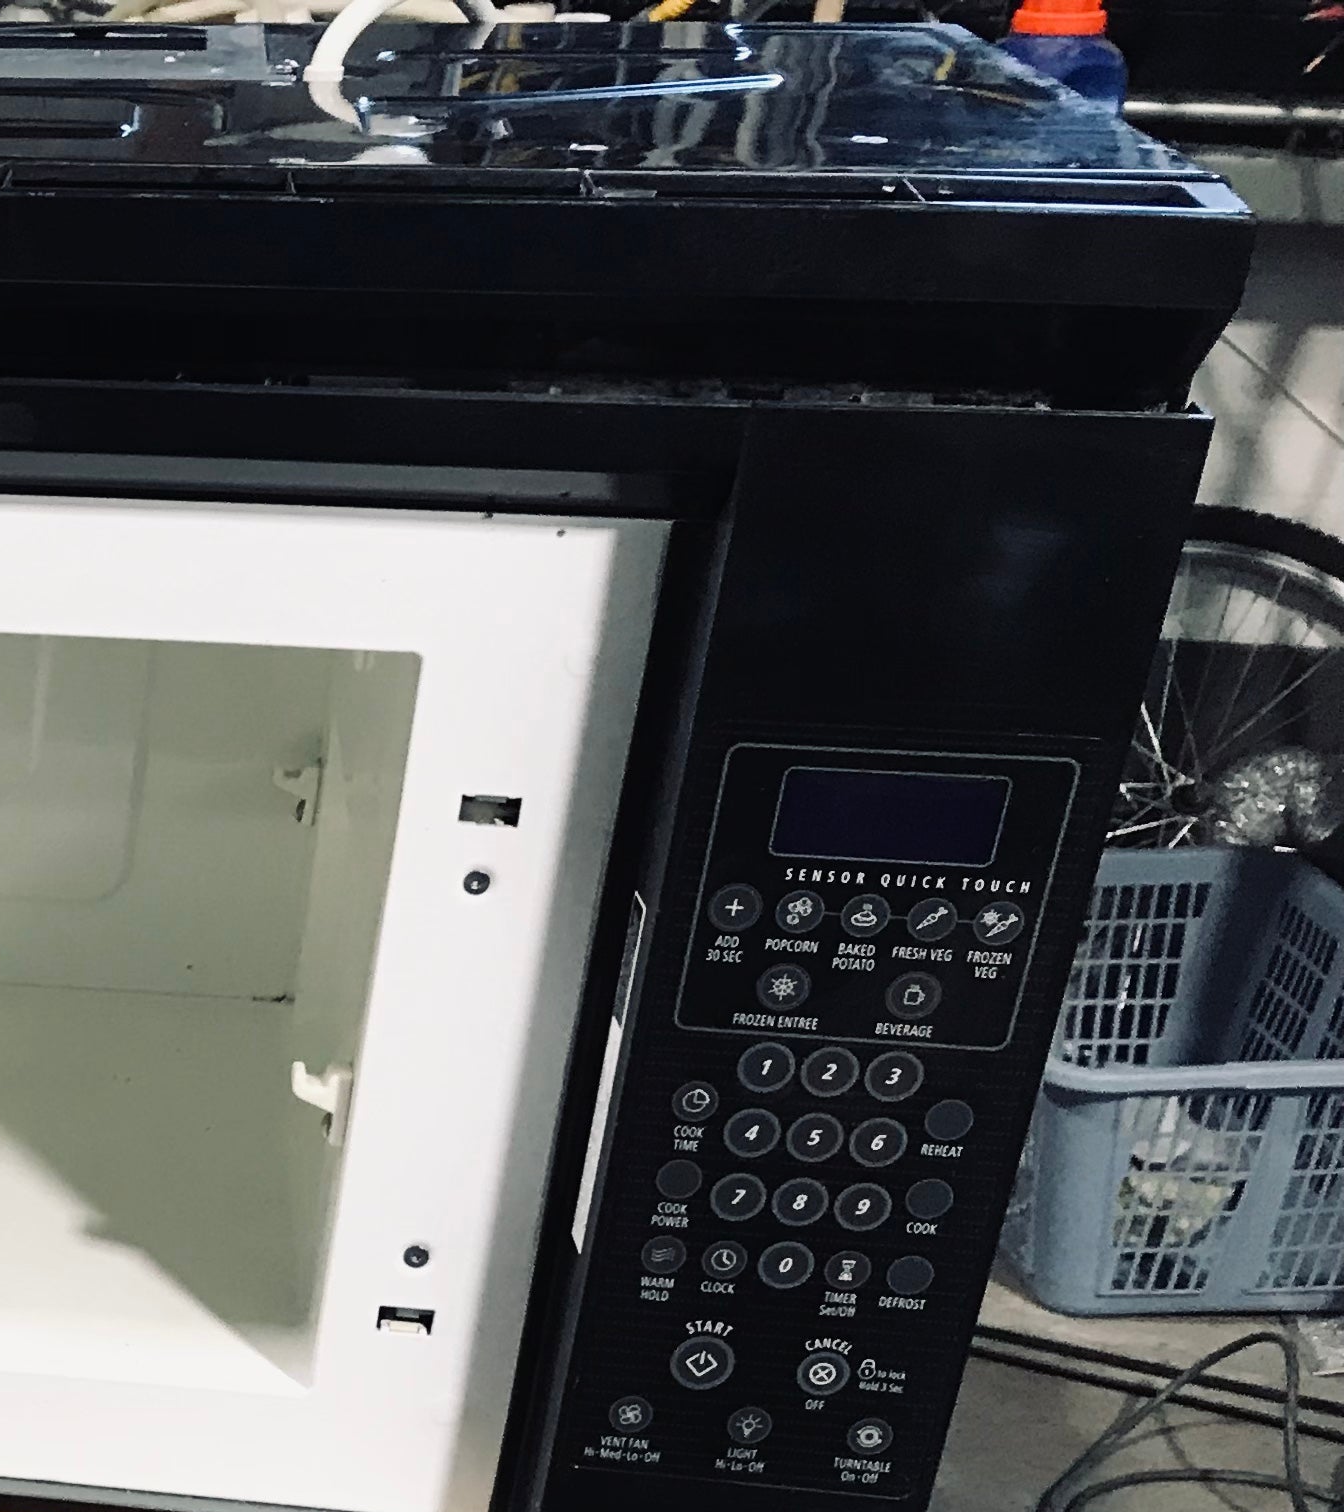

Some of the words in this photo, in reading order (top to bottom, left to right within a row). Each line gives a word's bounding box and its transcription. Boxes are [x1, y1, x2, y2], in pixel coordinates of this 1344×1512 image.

[785, 868, 865, 884] SENSOR
[880, 873, 946, 889] QUICK
[962, 878, 1031, 893] TOUCH
[715, 935, 739, 948] ADD
[765, 938, 820, 953] POPCORN
[706, 949, 720, 962] 30
[722, 950, 743, 963] SEC
[838, 943, 876, 956] BAKED
[892, 946, 928, 960] FRESH
[930, 948, 953, 962] VEG
[832, 957, 875, 971] POTATO
[967, 951, 1012, 965] FROZEN
[974, 966, 997, 979] VEG
[732, 1012, 776, 1027] FROZEN
[777, 1016, 818, 1030] ENTREE
[875, 1022, 933, 1038] BEVERAGE
[761, 1059, 773, 1075] 1
[821, 1063, 838, 1080] 2
[885, 1067, 902, 1085] 3
[673, 1125, 705, 1138] COOK
[745, 1125, 760, 1141] 4
[807, 1129, 823, 1146] 5
[674, 1139, 699, 1152] TIME
[870, 1134, 887, 1151] 6
[920, 1143, 964, 1158] REHEAT
[731, 1189, 747, 1204] 7
[792, 1194, 808, 1210] 8
[657, 1202, 688, 1214] COOK
[855, 1198, 871, 1215] 9
[650, 1215, 690, 1228] POWER
[906, 1221, 938, 1235] COOK
[779, 1257, 793, 1273] 0
[640, 1276, 675, 1289] WARM
[700, 1281, 736, 1294] CLOCK
[640, 1289, 669, 1302] HOLD
[824, 1291, 858, 1305] TIMER
[878, 1296, 927, 1310] DEFROST
[686, 1320, 734, 1337] START
[805, 1338, 853, 1355] CANCEL
[889, 1369, 906, 1380] lock
[805, 1399, 825, 1411] OFF
[601, 1436, 627, 1448] VENT
[628, 1437, 650, 1450] FAN
[727, 1447, 758, 1460] LIGHT
[834, 1457, 892, 1473] TURNTABLE
